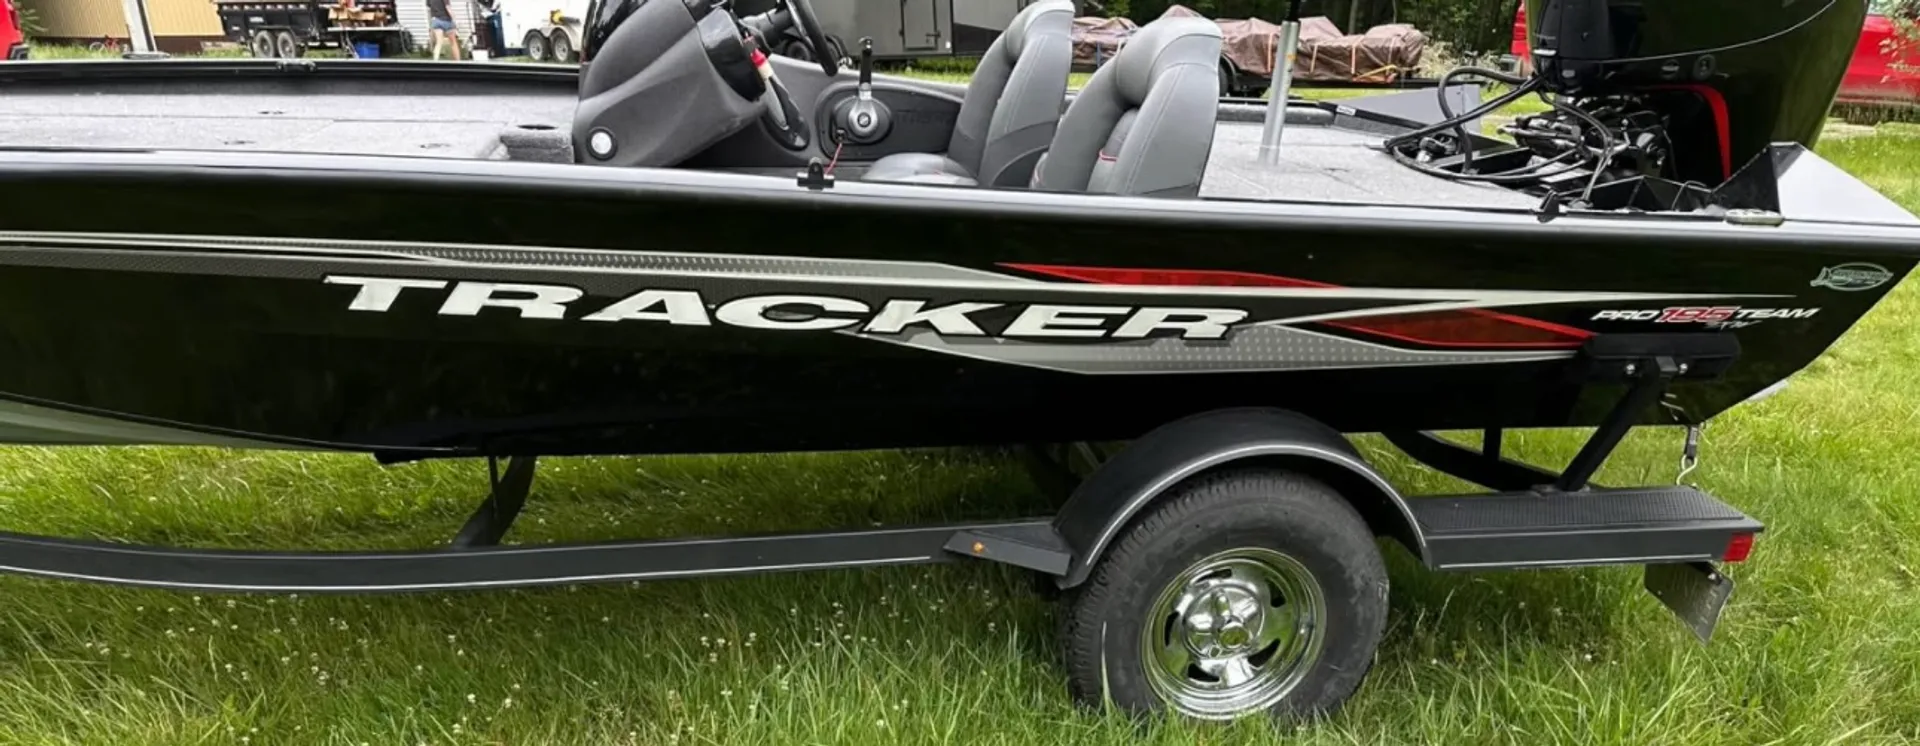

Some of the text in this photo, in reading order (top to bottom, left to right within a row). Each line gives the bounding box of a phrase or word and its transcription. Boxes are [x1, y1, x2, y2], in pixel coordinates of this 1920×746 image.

[322, 274, 1249, 341] TRACKER
[1590, 305, 1821, 323] PRO 195 TEAM
